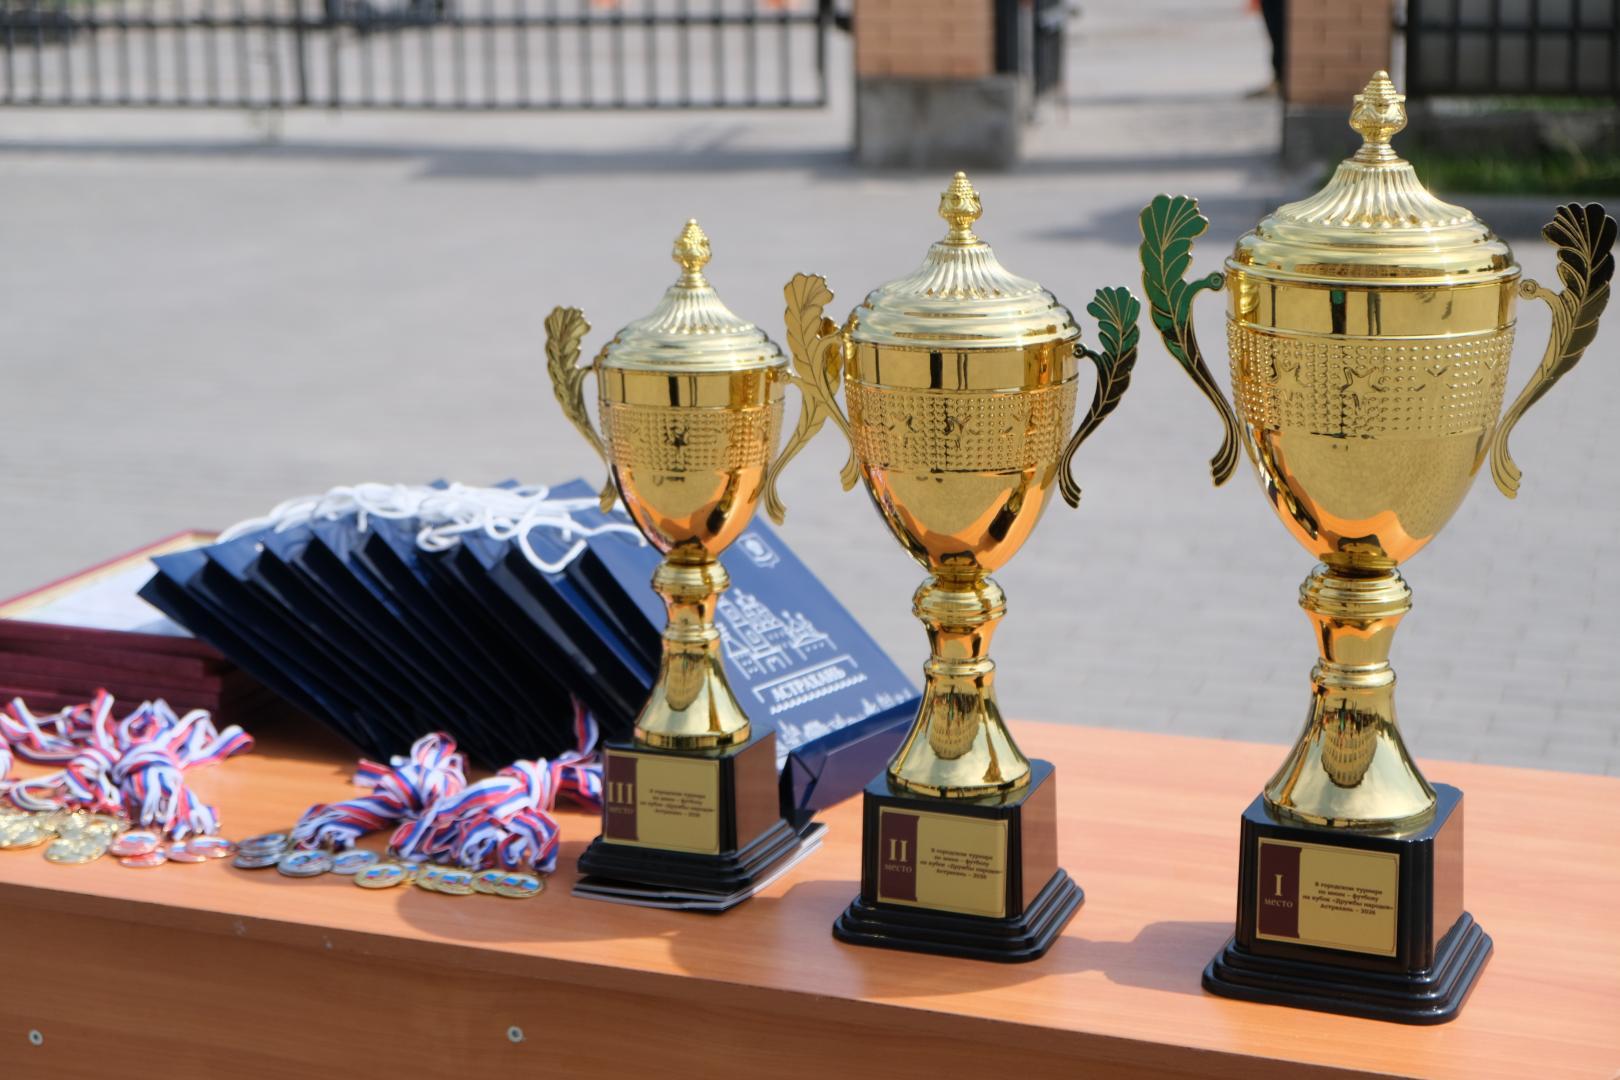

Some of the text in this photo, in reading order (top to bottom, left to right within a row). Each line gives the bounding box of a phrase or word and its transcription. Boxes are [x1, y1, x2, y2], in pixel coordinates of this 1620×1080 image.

[771, 666, 846, 702] АСТРАХАНЬ
[607, 781, 633, 804] III
[888, 838, 908, 862] II
[1274, 874, 1283, 896] I
